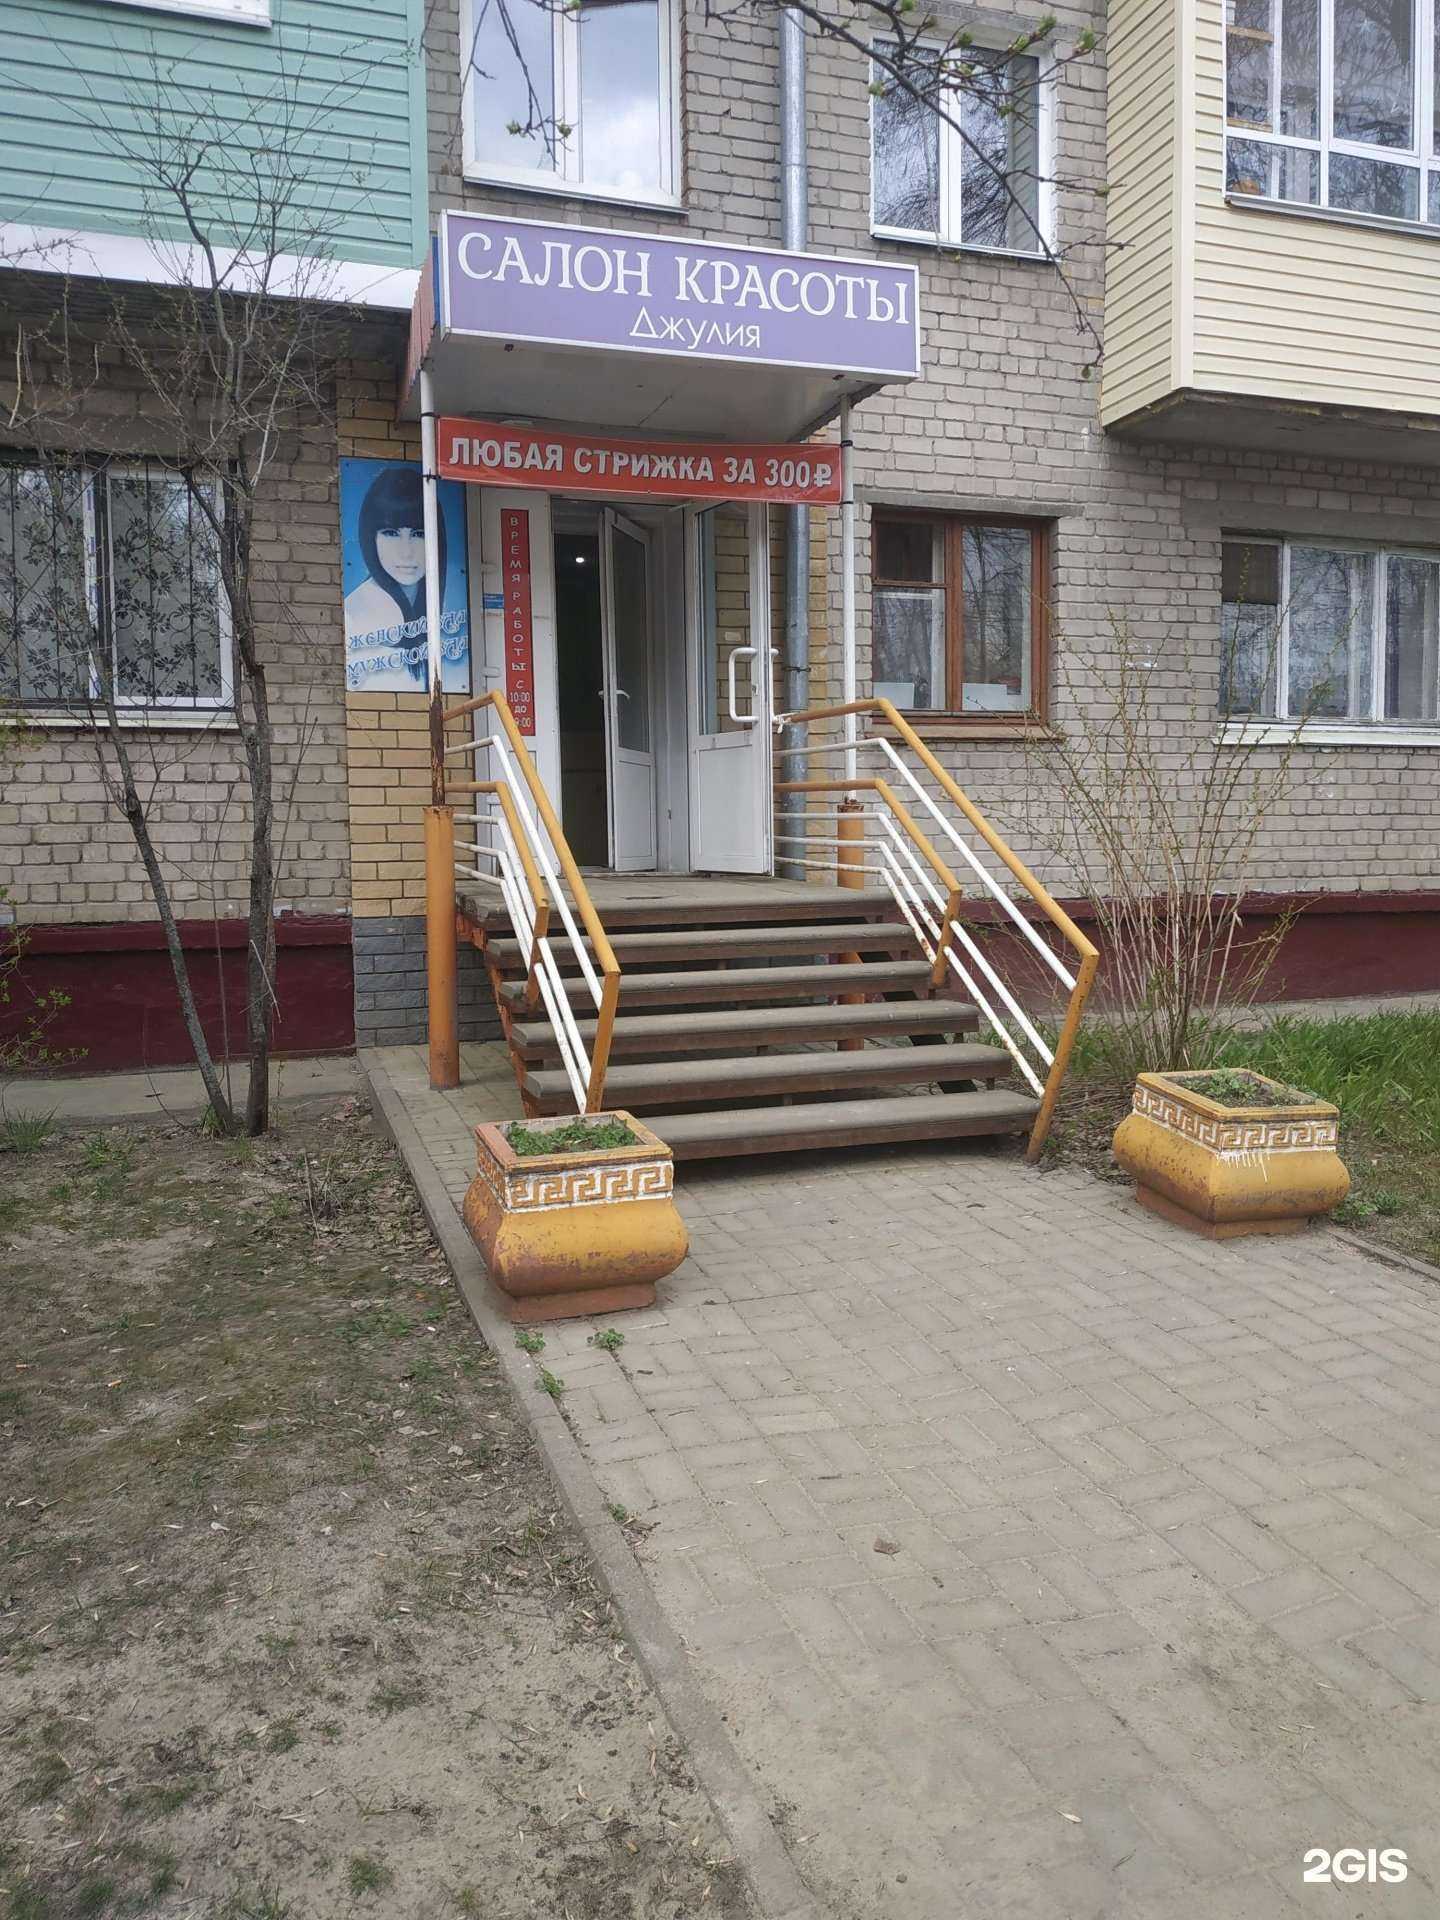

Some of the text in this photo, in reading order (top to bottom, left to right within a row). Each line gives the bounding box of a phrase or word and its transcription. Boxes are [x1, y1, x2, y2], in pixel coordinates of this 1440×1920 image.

[458, 231, 909, 325] САЛОН КРАСОТЫ
[629, 306, 761, 350] Джулия
[449, 437, 564, 472] ЛЮБАЯ
[573, 447, 715, 482] СТРИЖКА
[722, 457, 756, 485] ЗА
[509, 516, 522, 583] ВРЕМЯ
[513, 717, 531, 728] 9:00
